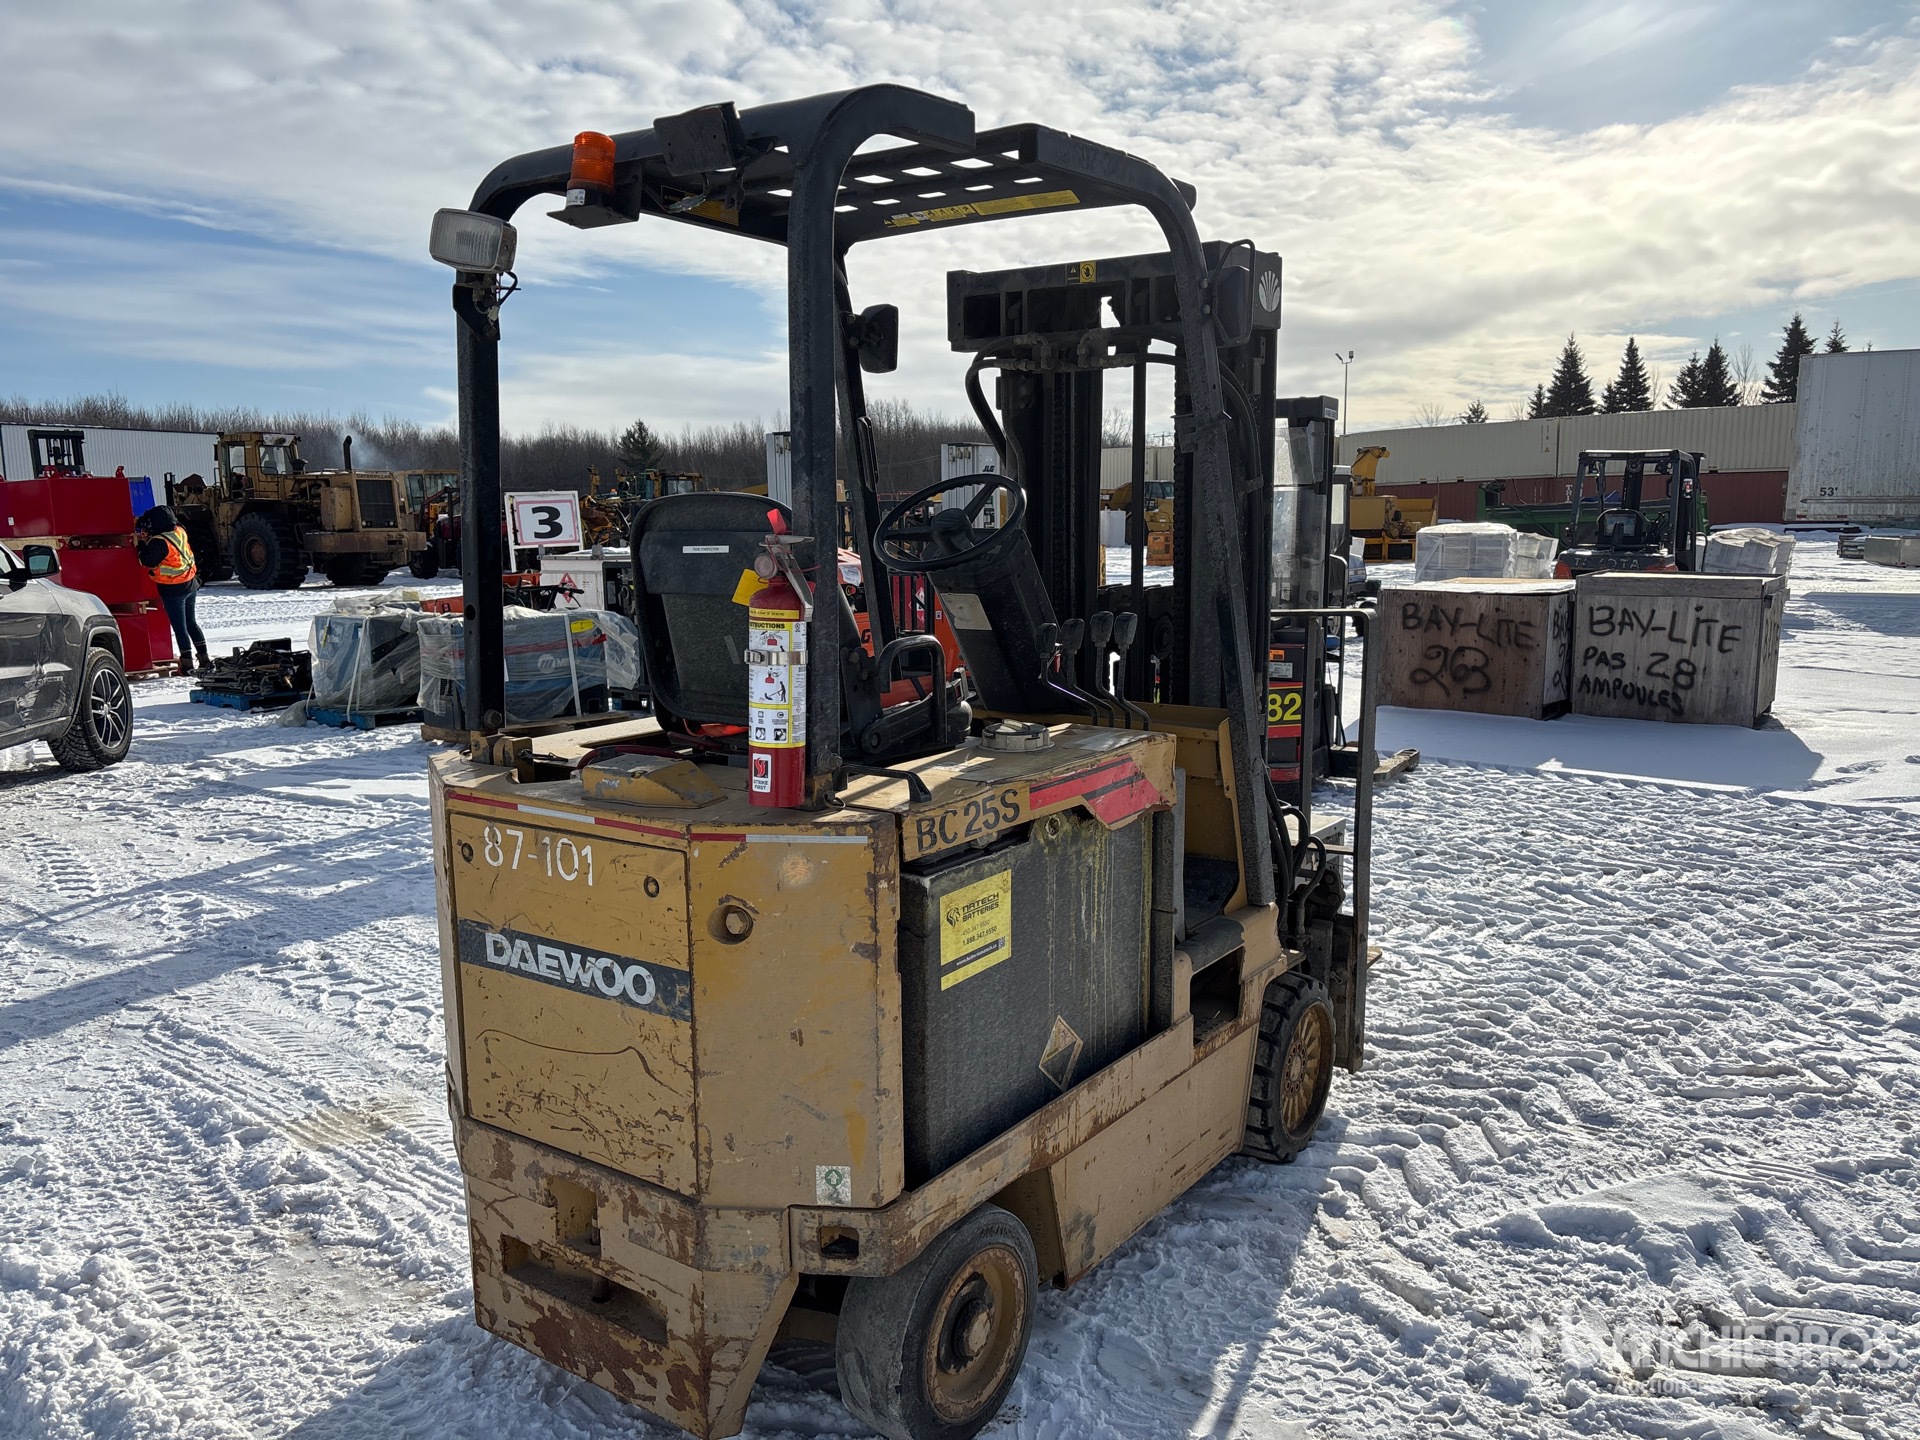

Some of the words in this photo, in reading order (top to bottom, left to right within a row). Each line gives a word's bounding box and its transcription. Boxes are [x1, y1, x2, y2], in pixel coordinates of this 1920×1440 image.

[982, 465, 995, 473] JLG
[1820, 487, 1839, 497] 53'
[531, 505, 563, 539] 3
[1583, 645, 1627, 670] PAS
[1645, 652, 1698, 691] 28
[1267, 692, 1302, 722] 82
[1578, 674, 1685, 716] AMPOULES
[483, 825, 594, 887] 87-101
[962, 892, 1000, 913] NATECH
[962, 902, 1000, 923] BATTERIES
[485, 932, 657, 1006] DAEWOO
